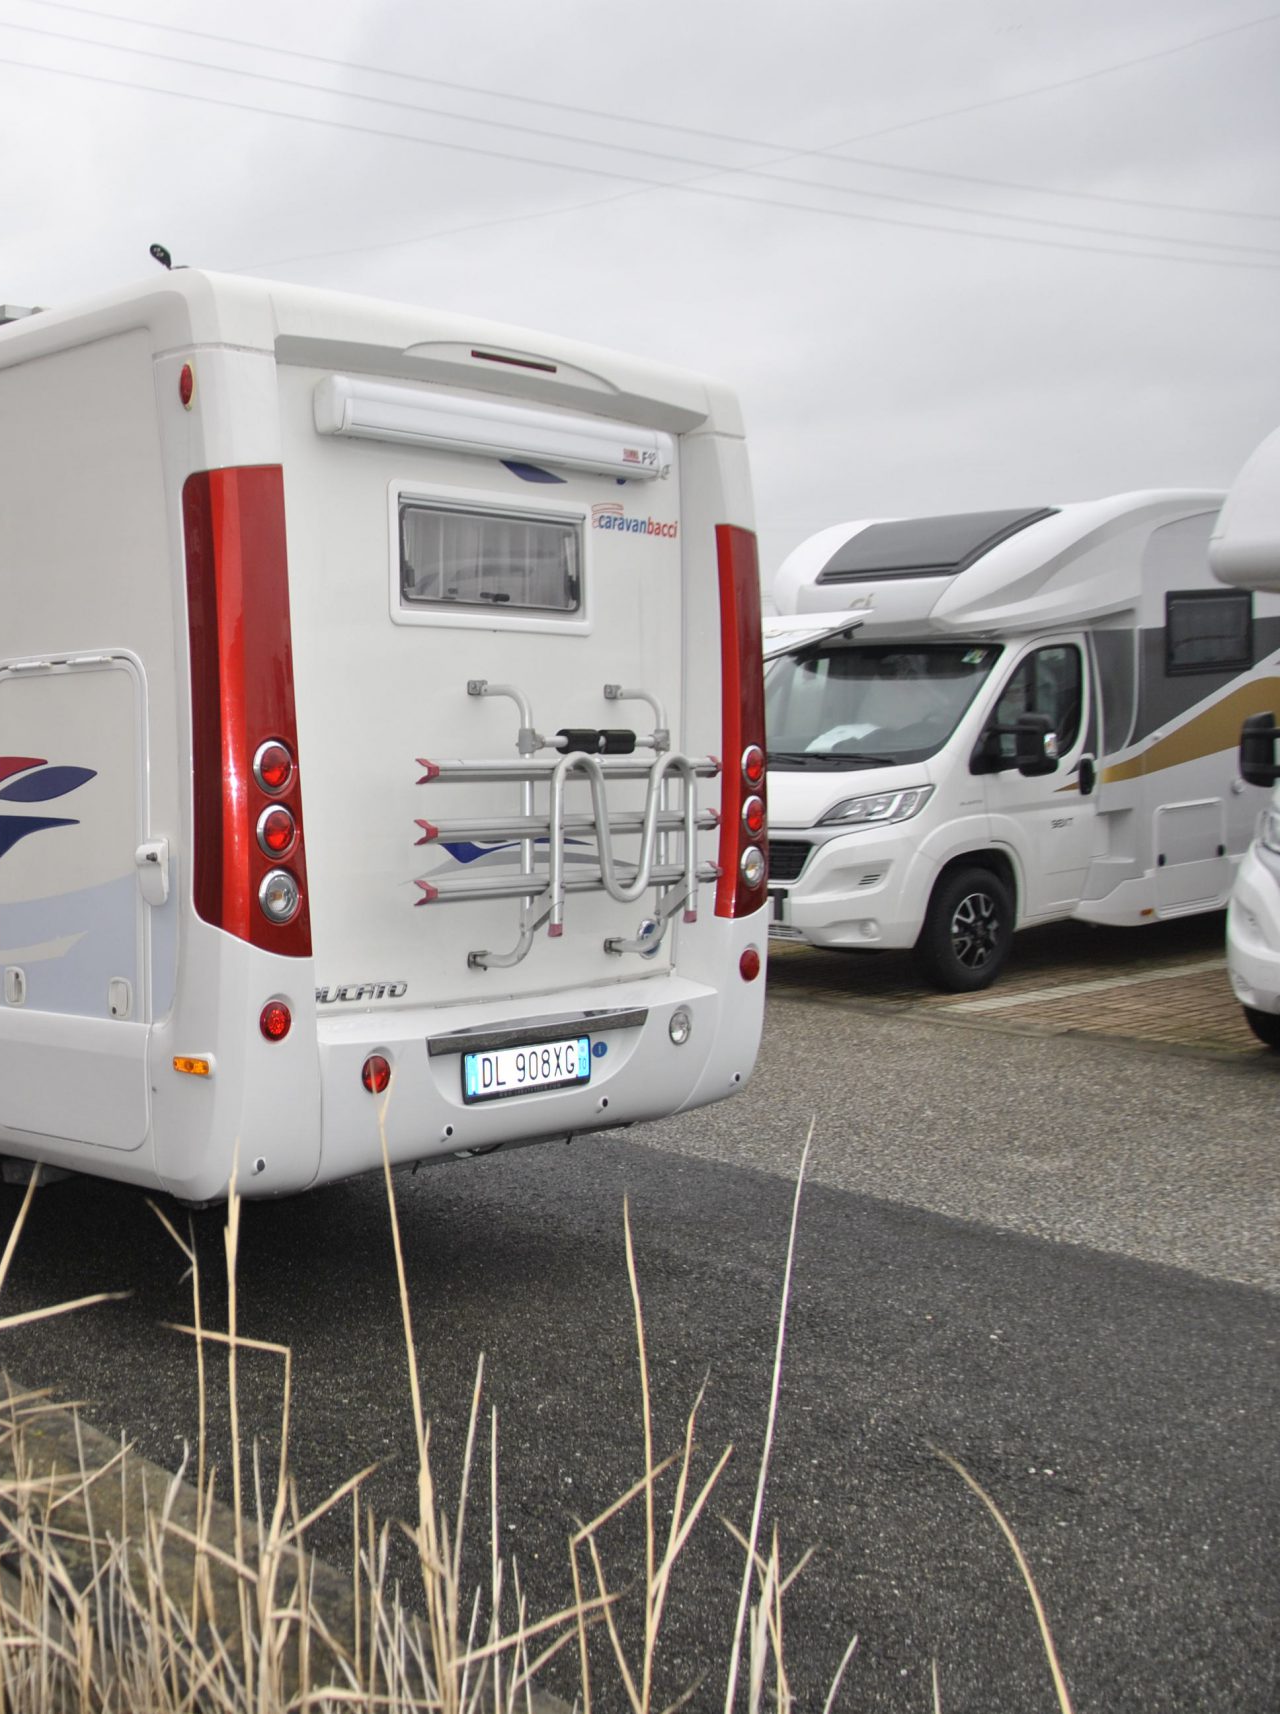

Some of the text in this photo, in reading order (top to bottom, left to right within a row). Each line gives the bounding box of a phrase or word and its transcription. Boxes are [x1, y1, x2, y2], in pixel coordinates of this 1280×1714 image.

[599, 514, 678, 538] caravanbacci
[482, 1045, 575, 1088] DL 908XG
